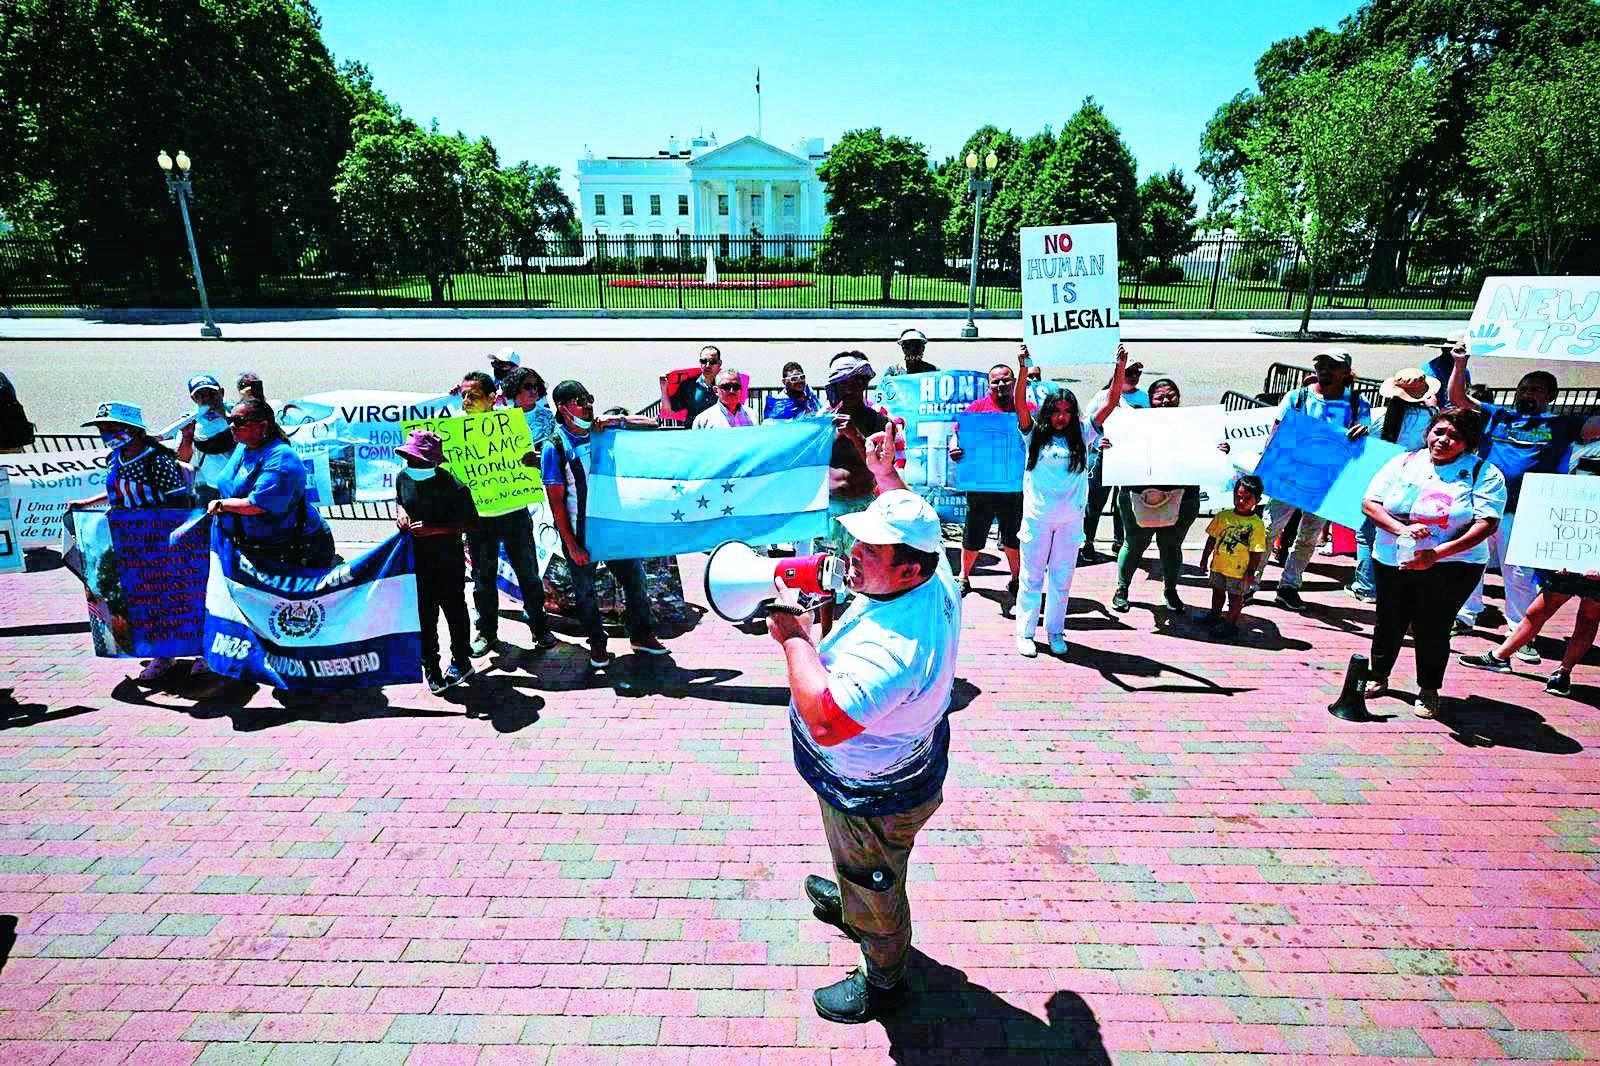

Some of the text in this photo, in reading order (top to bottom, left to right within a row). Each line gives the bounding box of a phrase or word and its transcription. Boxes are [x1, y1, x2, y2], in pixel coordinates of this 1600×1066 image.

[1044, 233, 1073, 254] NO
[1026, 254, 1105, 280] HUMAN
[1052, 282, 1077, 304] IS
[1487, 284, 1600, 322] NEW
[1031, 308, 1119, 336] ILLEGAL
[1513, 320, 1600, 355] TPS
[341, 405, 452, 423] VIRGINIA
[463, 412, 514, 441] FOR
[31, 475, 82, 488] North
[28, 502, 53, 511] Una
[1550, 507, 1598, 523] NEED
[24, 514, 39, 523] de
[21, 527, 37, 537] de
[43, 528, 57, 537] tu
[1553, 523, 1600, 540] YOUR
[211, 632, 251, 660] DIOS
[310, 652, 380, 677] LIBERTAD
